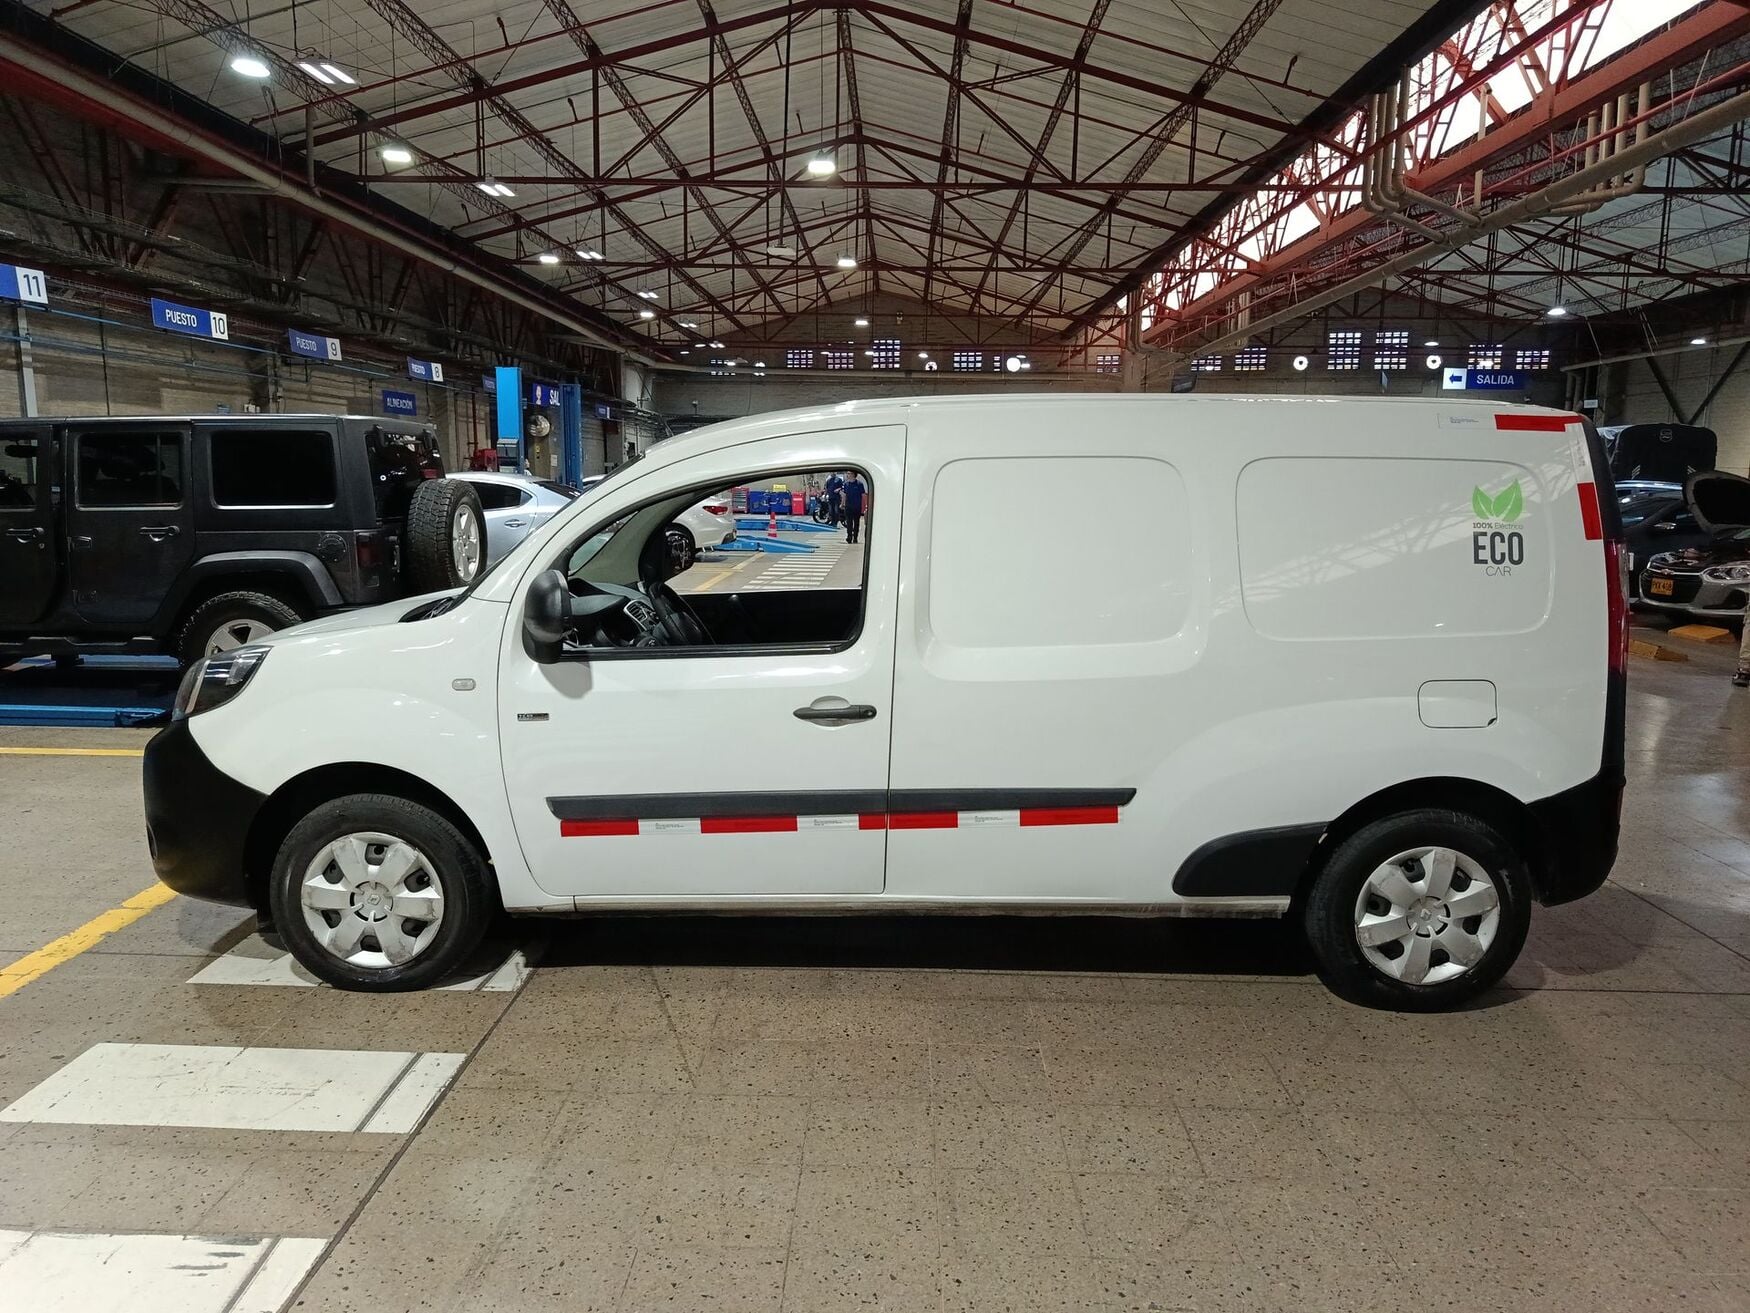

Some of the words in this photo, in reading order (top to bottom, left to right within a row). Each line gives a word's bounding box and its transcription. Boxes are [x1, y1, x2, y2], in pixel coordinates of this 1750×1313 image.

[23, 273, 42, 297] 11
[165, 309, 198, 327] PUESTO
[212, 316, 226, 335] 10
[295, 336, 317, 352] PUESTO
[330, 342, 338, 357] 9
[1476, 374, 1515, 385] SALIDA
[549, 388, 561, 406] SAL
[1473, 531, 1524, 565] ECO
[1485, 566, 1512, 576] CAR
